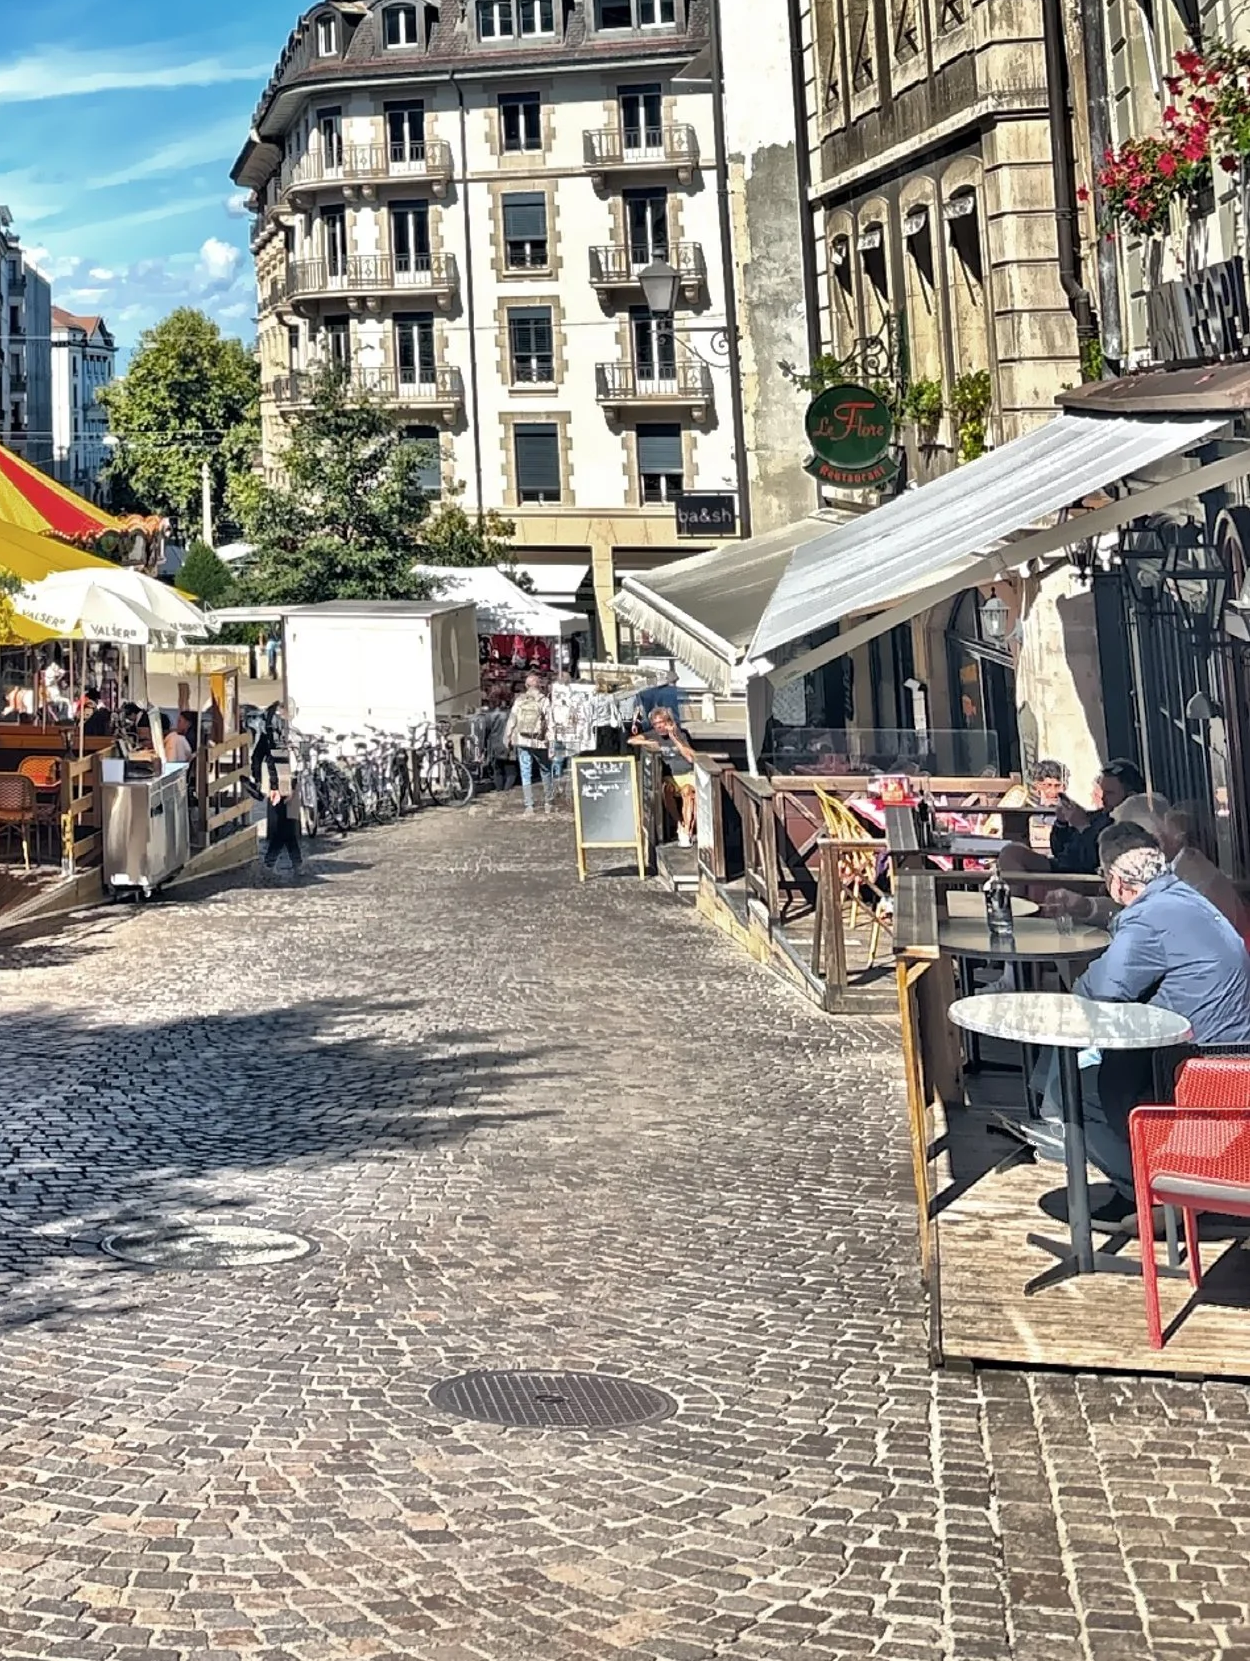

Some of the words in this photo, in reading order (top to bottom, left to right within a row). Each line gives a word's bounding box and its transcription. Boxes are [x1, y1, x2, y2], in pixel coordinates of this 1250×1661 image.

[812, 417, 834, 437] Le
[830, 401, 885, 441] Flore
[819, 463, 886, 483] Restaurant
[678, 507, 731, 523] ba&sh
